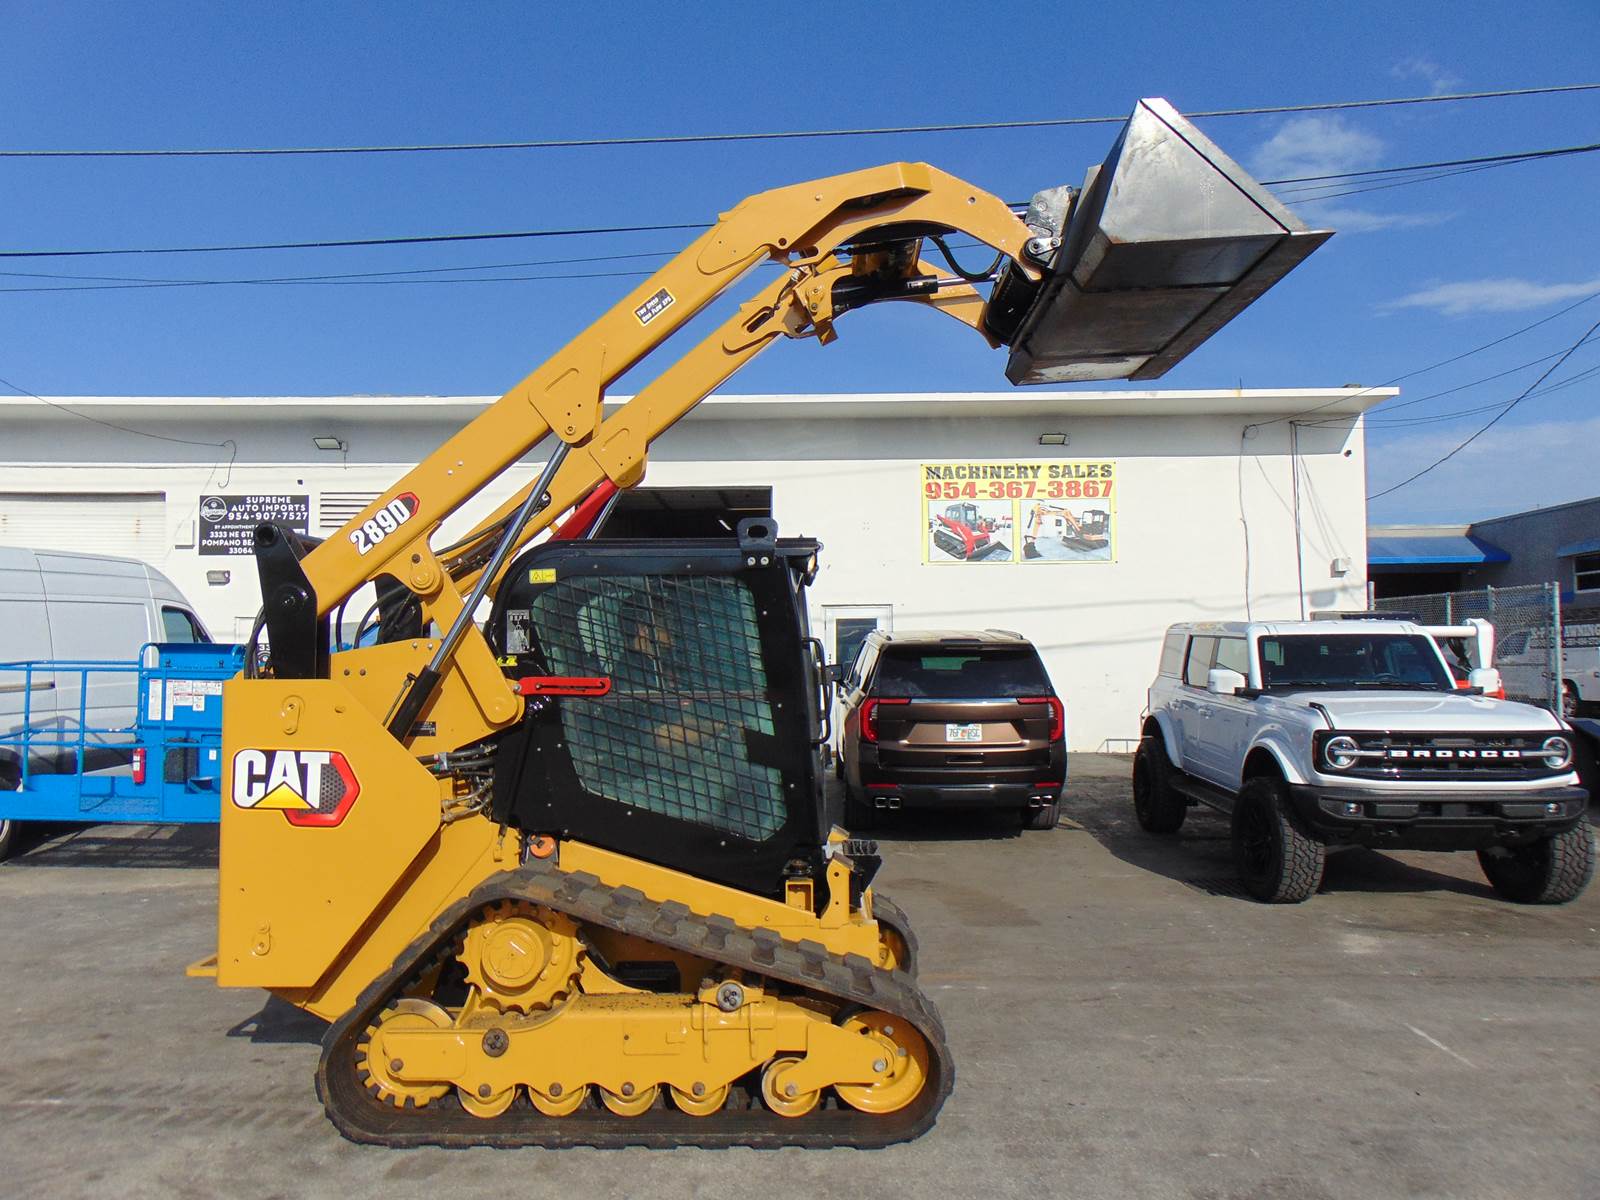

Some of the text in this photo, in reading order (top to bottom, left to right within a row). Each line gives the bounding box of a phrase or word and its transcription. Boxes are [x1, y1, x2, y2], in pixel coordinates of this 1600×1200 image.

[925, 464, 1113, 480] MACHINERY SALES
[925, 480, 1113, 499] 954-367-3867
[246, 496, 291, 504] SUPREME
[231, 504, 306, 512] AUTO IMPORTS
[228, 512, 308, 521] 954-907-7527
[350, 499, 411, 555] 289D
[1390, 750, 1521, 758] BRONCO
[234, 749, 330, 809] CAT
